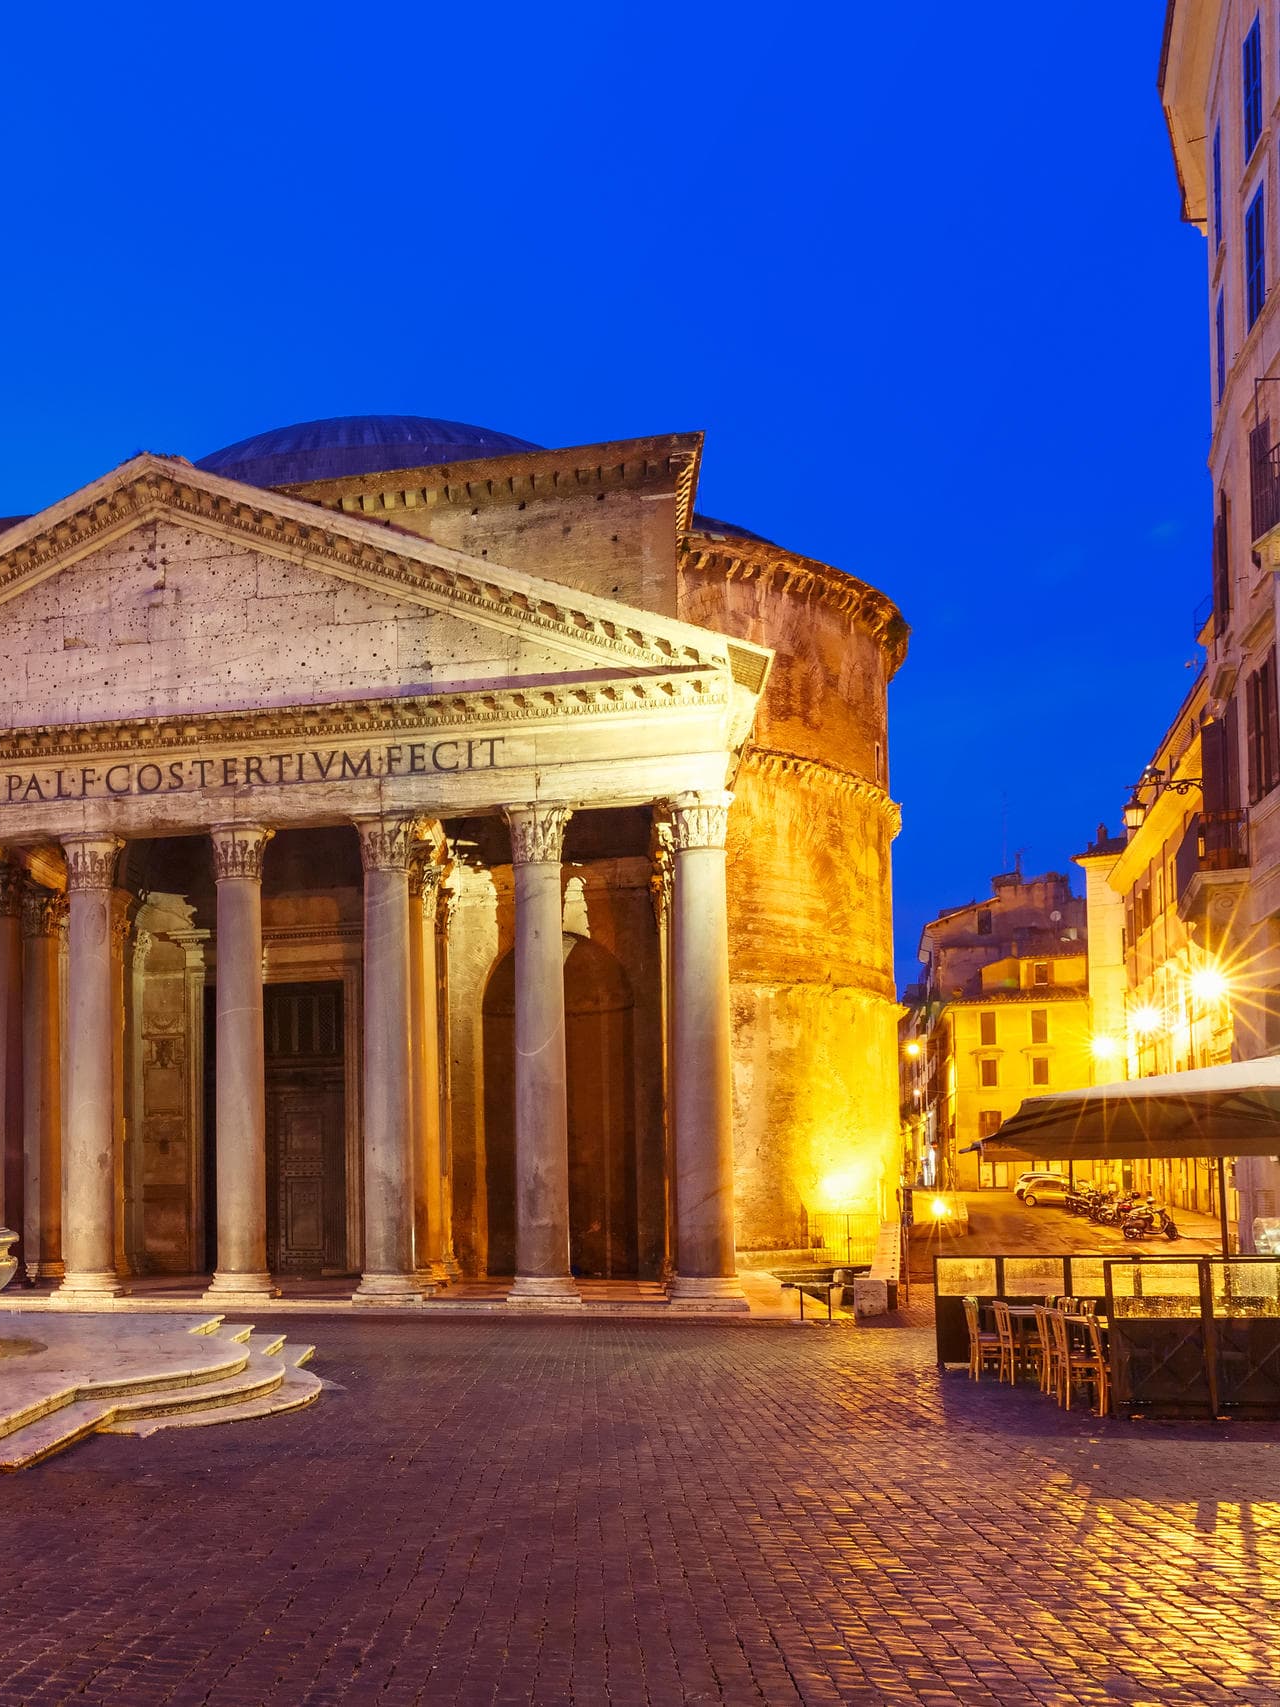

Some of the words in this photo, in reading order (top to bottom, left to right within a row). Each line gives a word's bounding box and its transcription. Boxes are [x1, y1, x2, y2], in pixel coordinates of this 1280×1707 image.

[105, 763, 184, 794] COS
[191, 749, 373, 788] TERTIVM
[384, 737, 506, 775] FECIT
